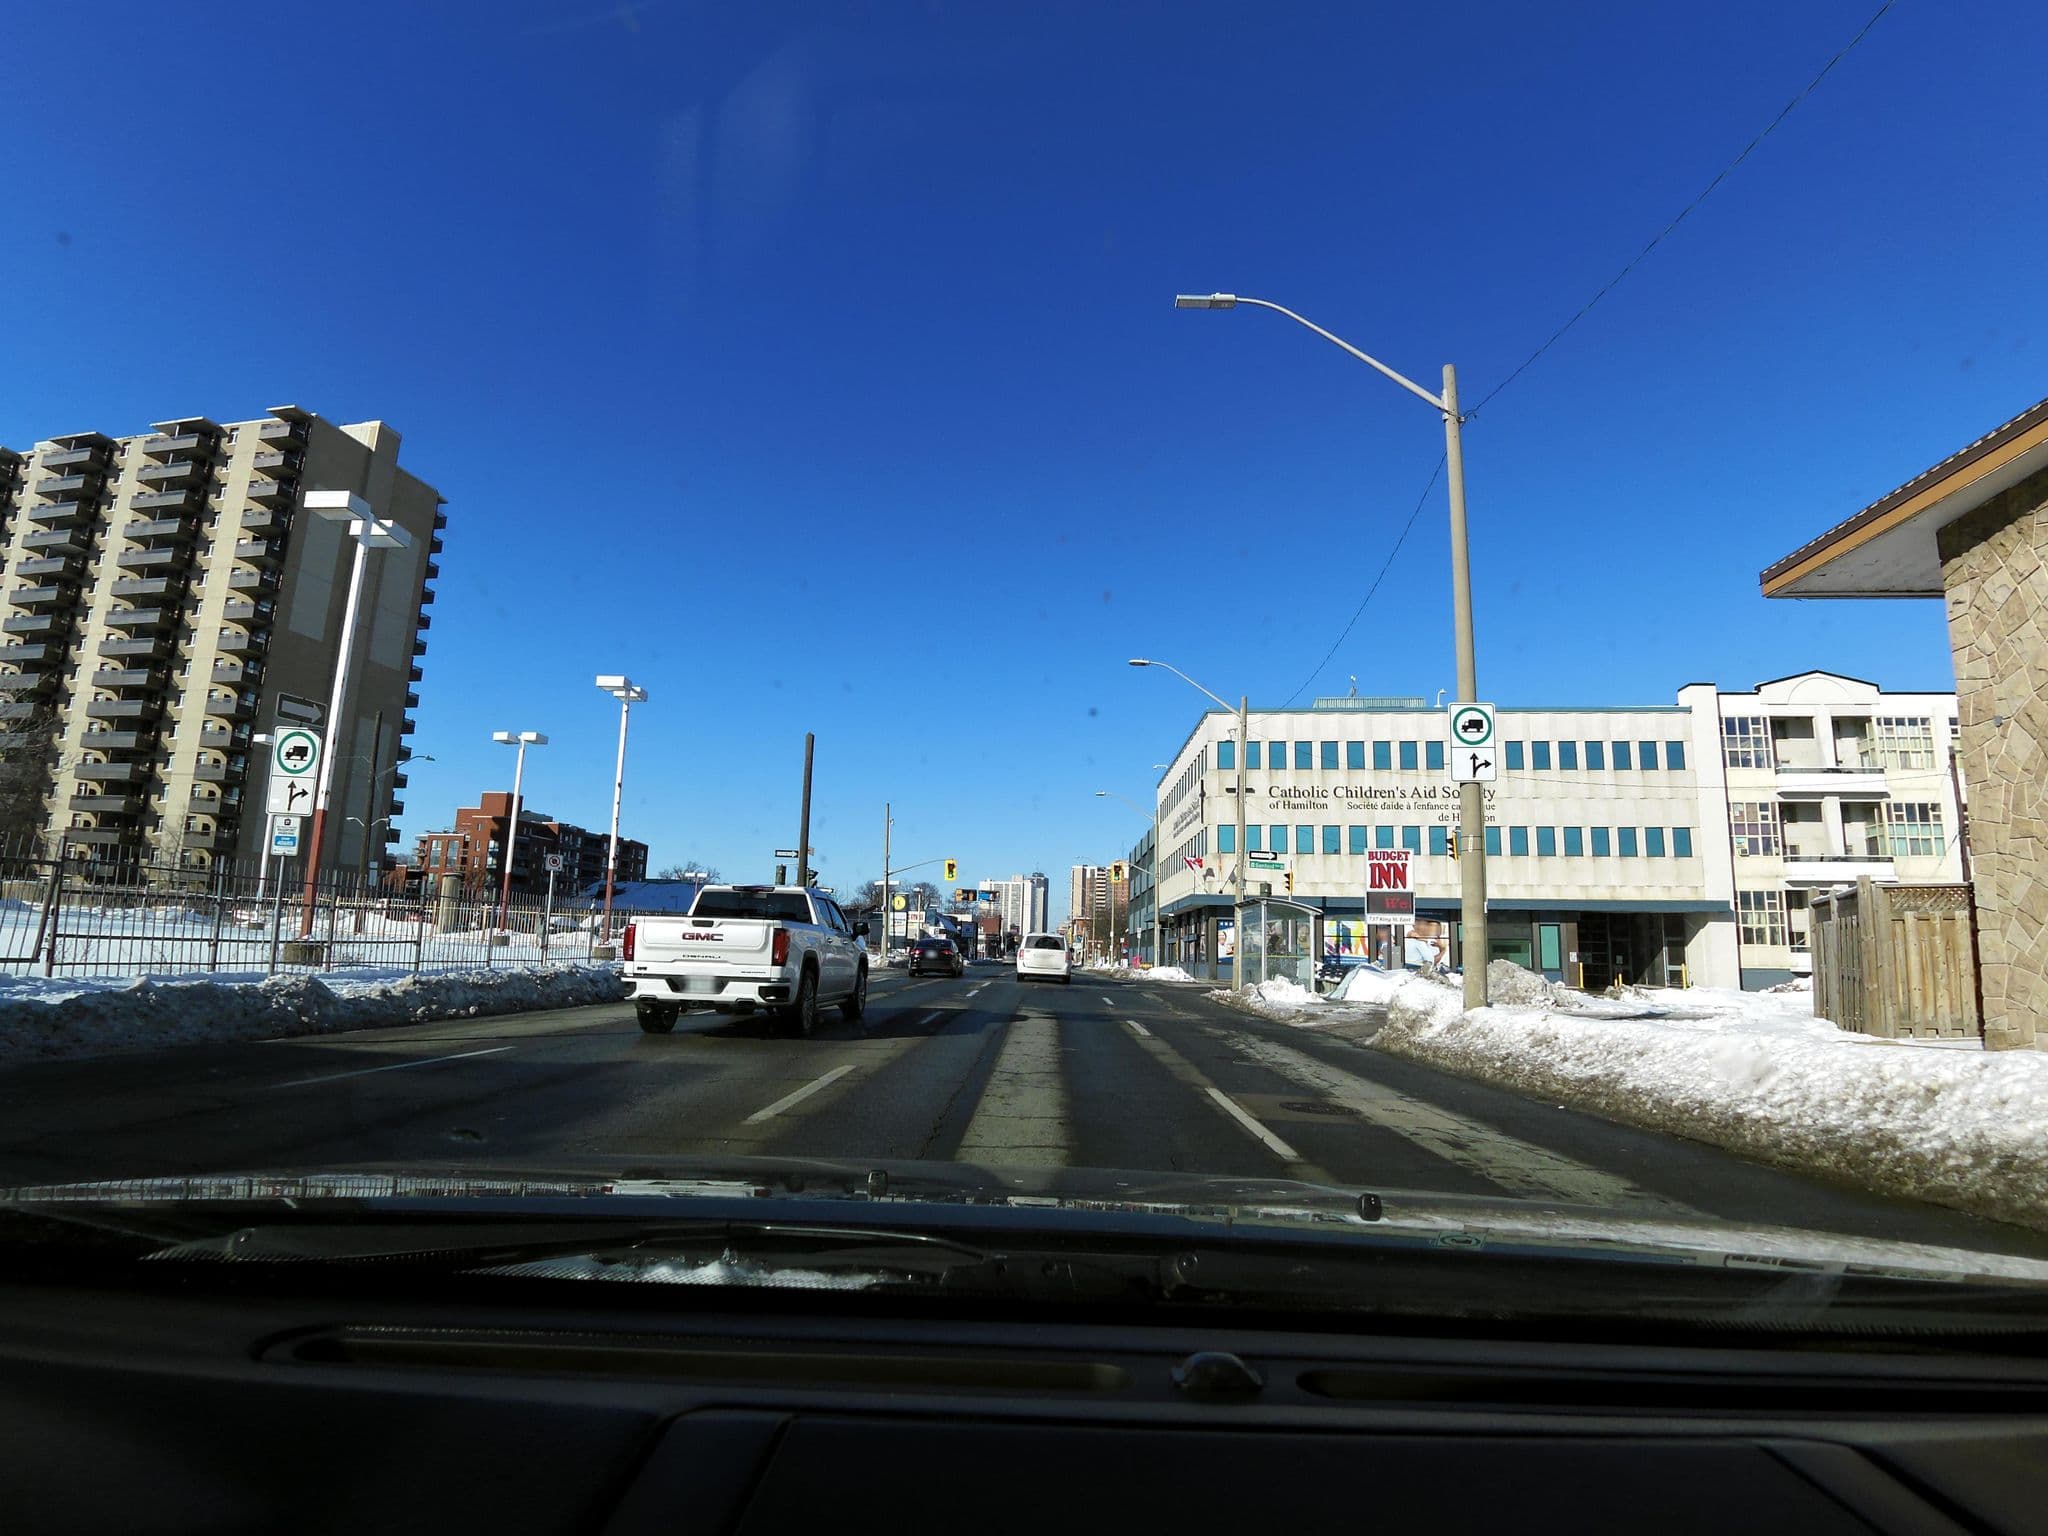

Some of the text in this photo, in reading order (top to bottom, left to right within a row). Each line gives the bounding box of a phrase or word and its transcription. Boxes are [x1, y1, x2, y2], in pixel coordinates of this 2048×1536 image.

[1268, 785, 1496, 802] Catholic Children's Aid Soty
[1269, 800, 1328, 810] of Hamilton
[1347, 801, 1379, 811] Société
[1438, 812, 1450, 823] de
[1367, 850, 1411, 862] BUDGET
[1369, 862, 1408, 889] INN
[681, 932, 724, 942] GMC
